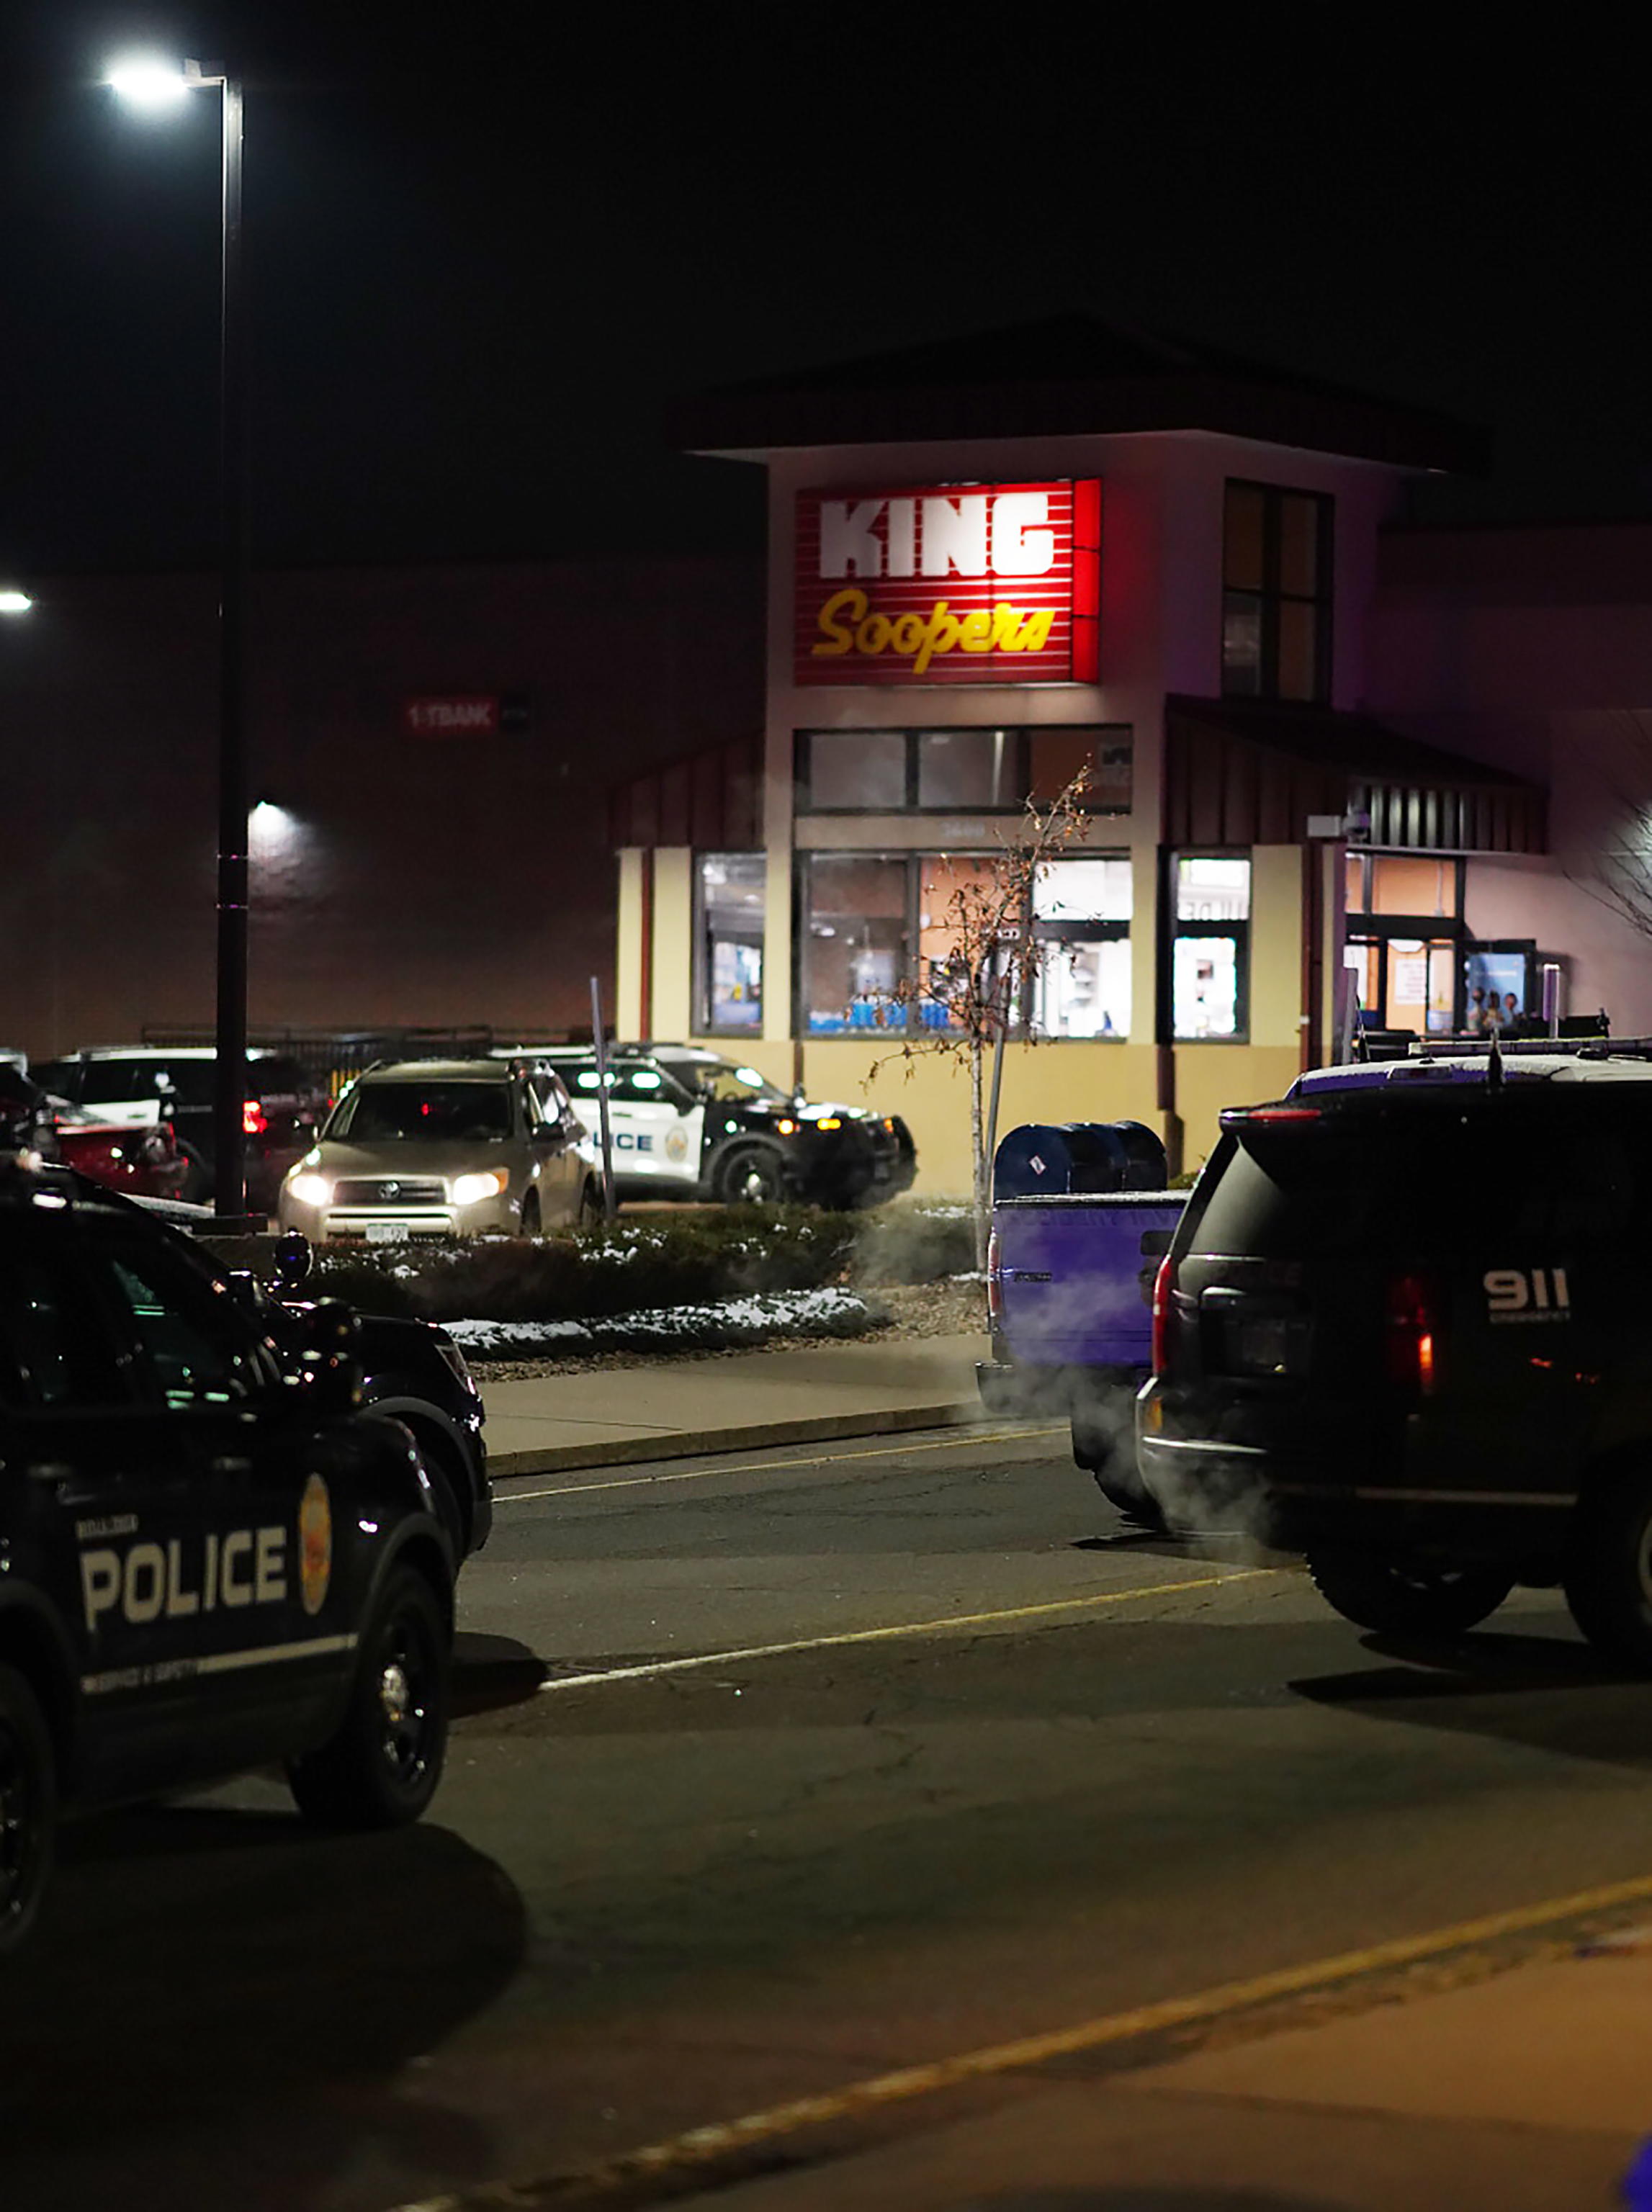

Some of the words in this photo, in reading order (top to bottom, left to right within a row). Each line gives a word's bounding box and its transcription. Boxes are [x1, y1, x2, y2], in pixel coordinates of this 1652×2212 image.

[820, 493, 1054, 578] KING
[811, 589, 1056, 674] Soopers
[1483, 1268, 1571, 1310] 911
[80, 1525, 287, 1632] POLICE
